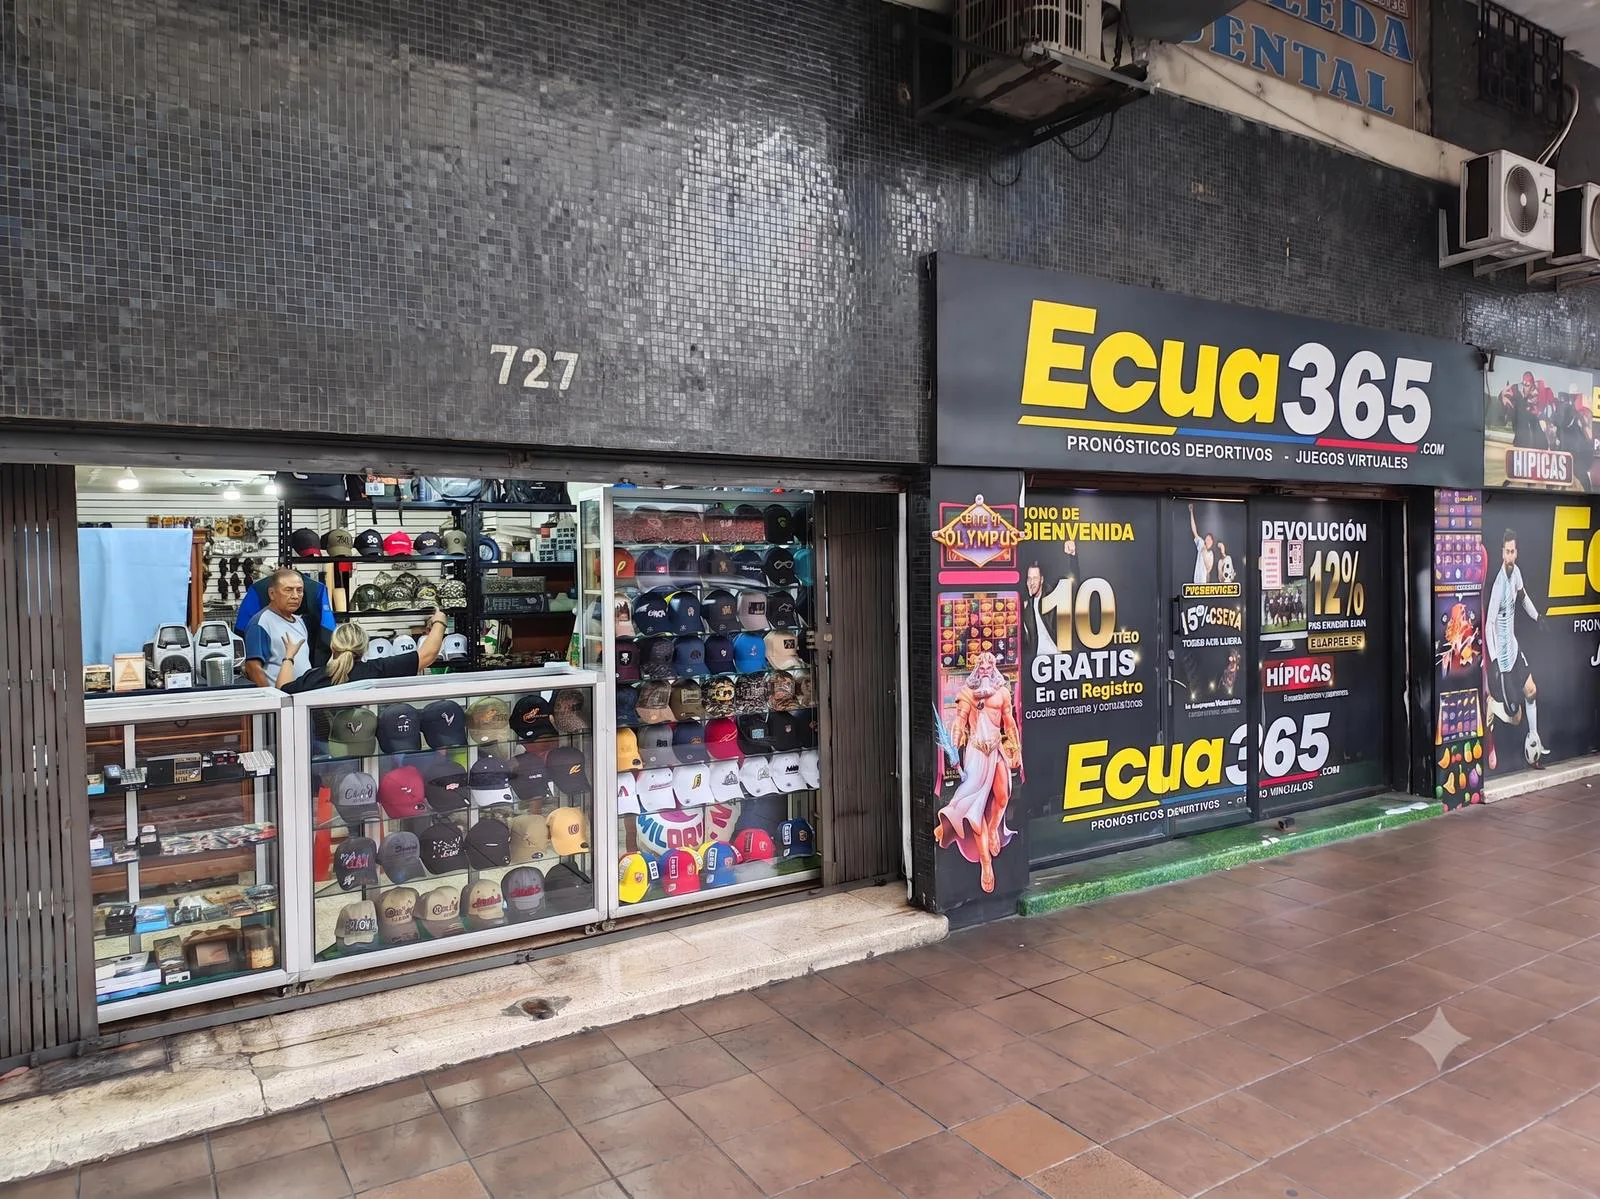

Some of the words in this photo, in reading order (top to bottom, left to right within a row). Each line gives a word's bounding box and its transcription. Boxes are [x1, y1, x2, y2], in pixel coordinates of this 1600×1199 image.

[1181, 13, 1394, 117] ENTAL
[490, 344, 578, 390] 727
[1021, 300, 1432, 444] Ecua365
[1067, 435, 1180, 456] PRONÓSTICOS
[1186, 443, 1273, 462] DEPORTIVOS
[1296, 450, 1344, 466] JUEGOS
[1348, 453, 1408, 470] VIRTUALES
[1420, 442, 1445, 456] .COM
[1513, 450, 1567, 480] HIPICAS
[1062, 507, 1079, 520] DE
[945, 529, 1018, 547] OLYMPUS
[1024, 522, 1135, 541] BIENVENIDA
[1262, 519, 1367, 541] DEVOLUCIÓN
[1548, 506, 1600, 598] E
[1310, 550, 1364, 617] 12%
[1041, 577, 1116, 652] 10
[1031, 649, 1136, 684] GRATIS
[1266, 662, 1332, 687] HÍPICAS
[1036, 686, 1055, 703] En
[1060, 688, 1077, 700] en
[1082, 680, 1144, 700] Registro
[1064, 711, 1331, 810] Ecua365
[1091, 808, 1164, 831] PRONÓSTICOS
